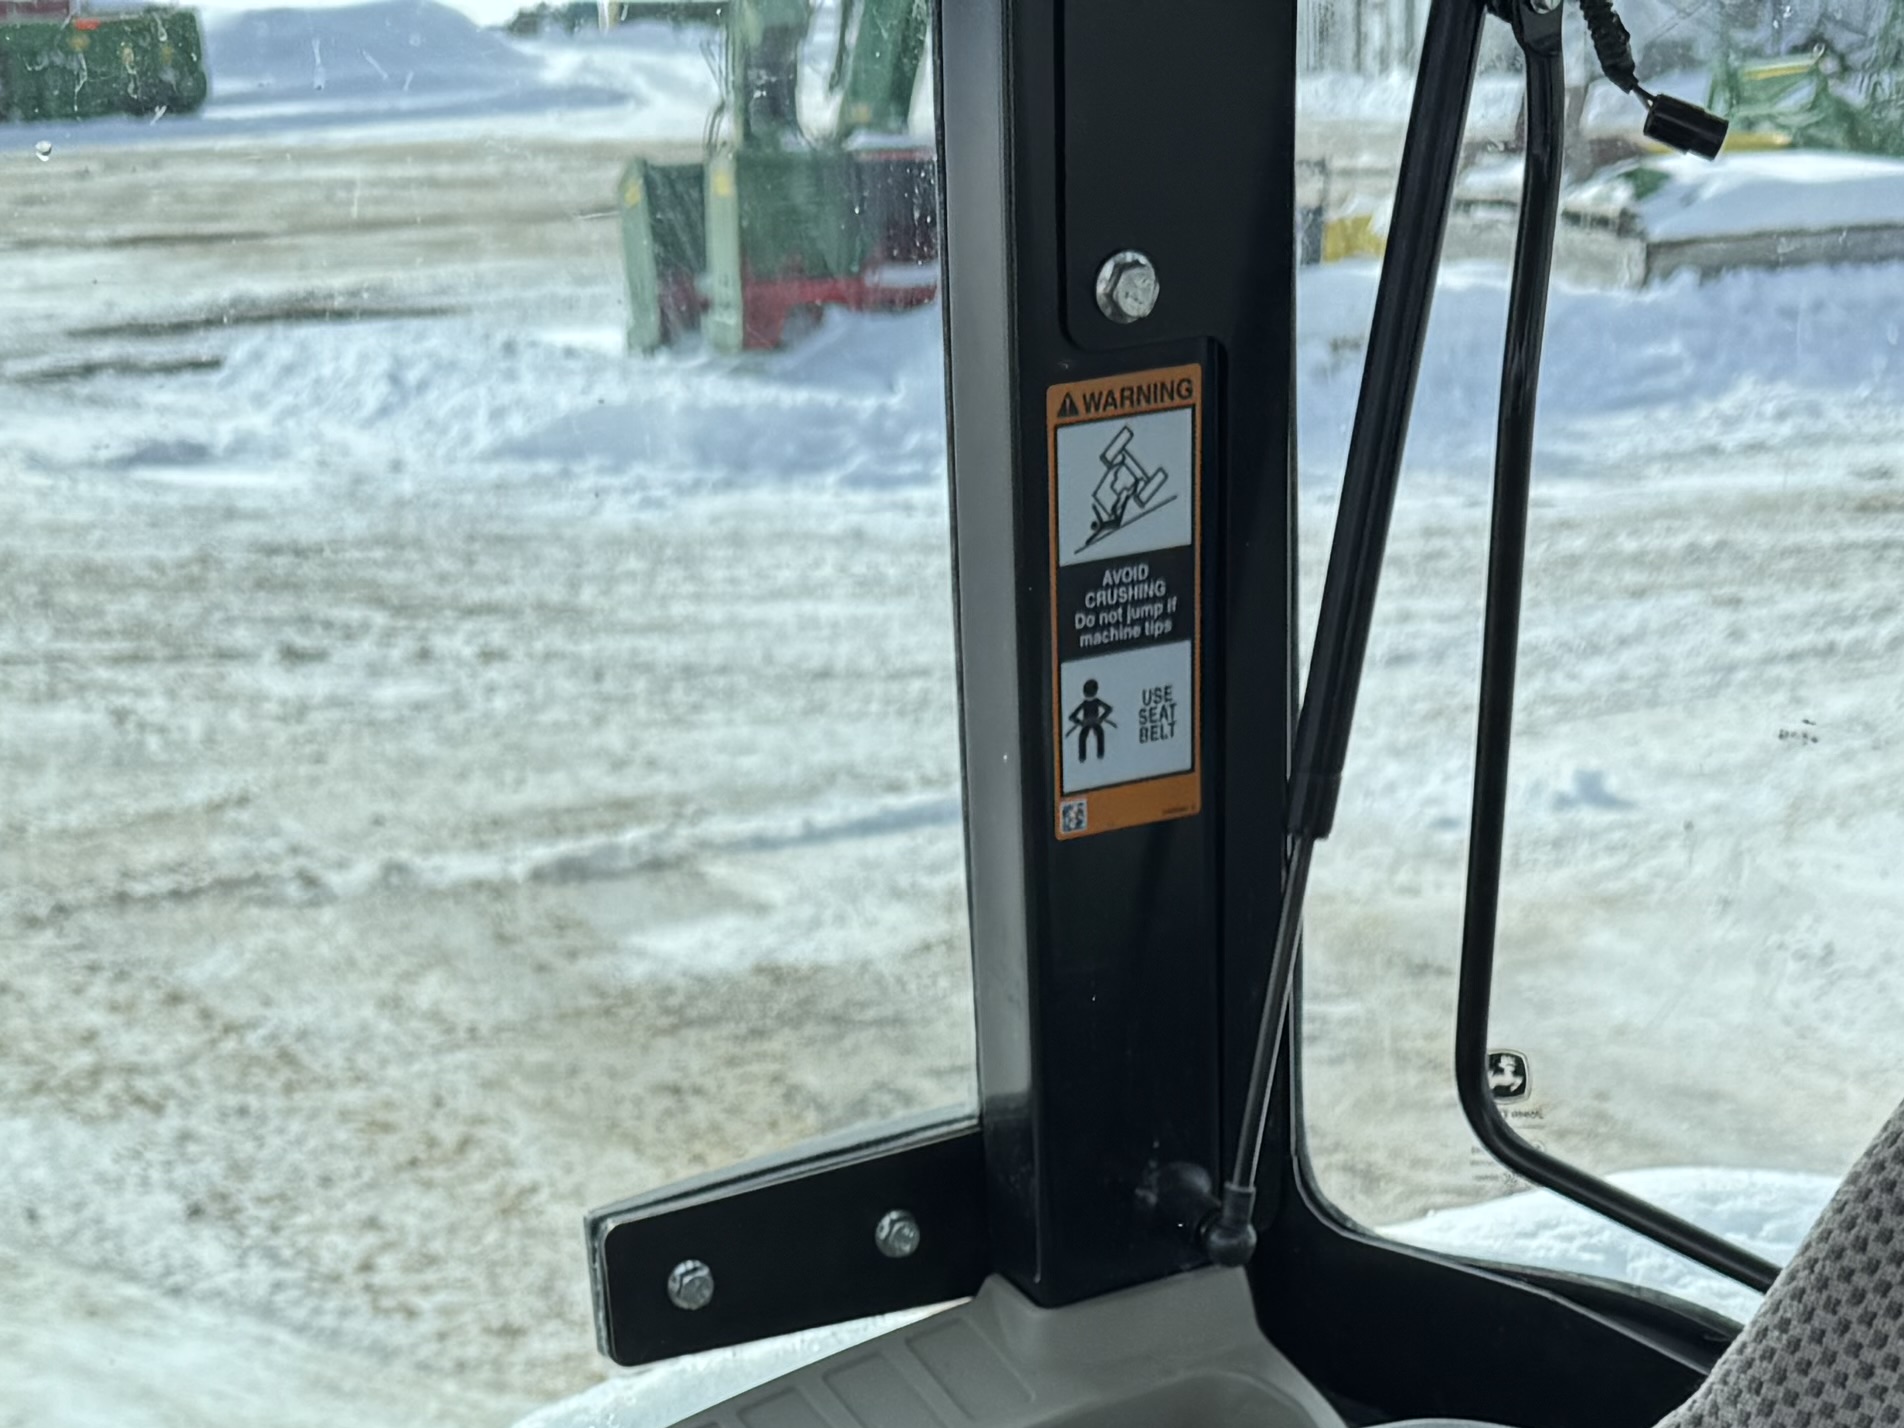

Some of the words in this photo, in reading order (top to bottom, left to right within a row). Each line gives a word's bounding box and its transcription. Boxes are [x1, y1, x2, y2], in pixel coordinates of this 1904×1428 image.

[1082, 377, 1193, 414] WARNING
[1102, 564, 1149, 587] AVOID
[1084, 579, 1166, 609] CRUSHING
[1074, 612, 1095, 630] Do
[1098, 605, 1123, 626] not
[1126, 602, 1163, 625] jump
[1166, 595, 1177, 614] if
[1079, 623, 1141, 648] machine
[1144, 618, 1172, 638] tips
[1142, 685, 1174, 707] USE
[1138, 702, 1177, 726] SEAT
[1139, 719, 1176, 744] BELT
